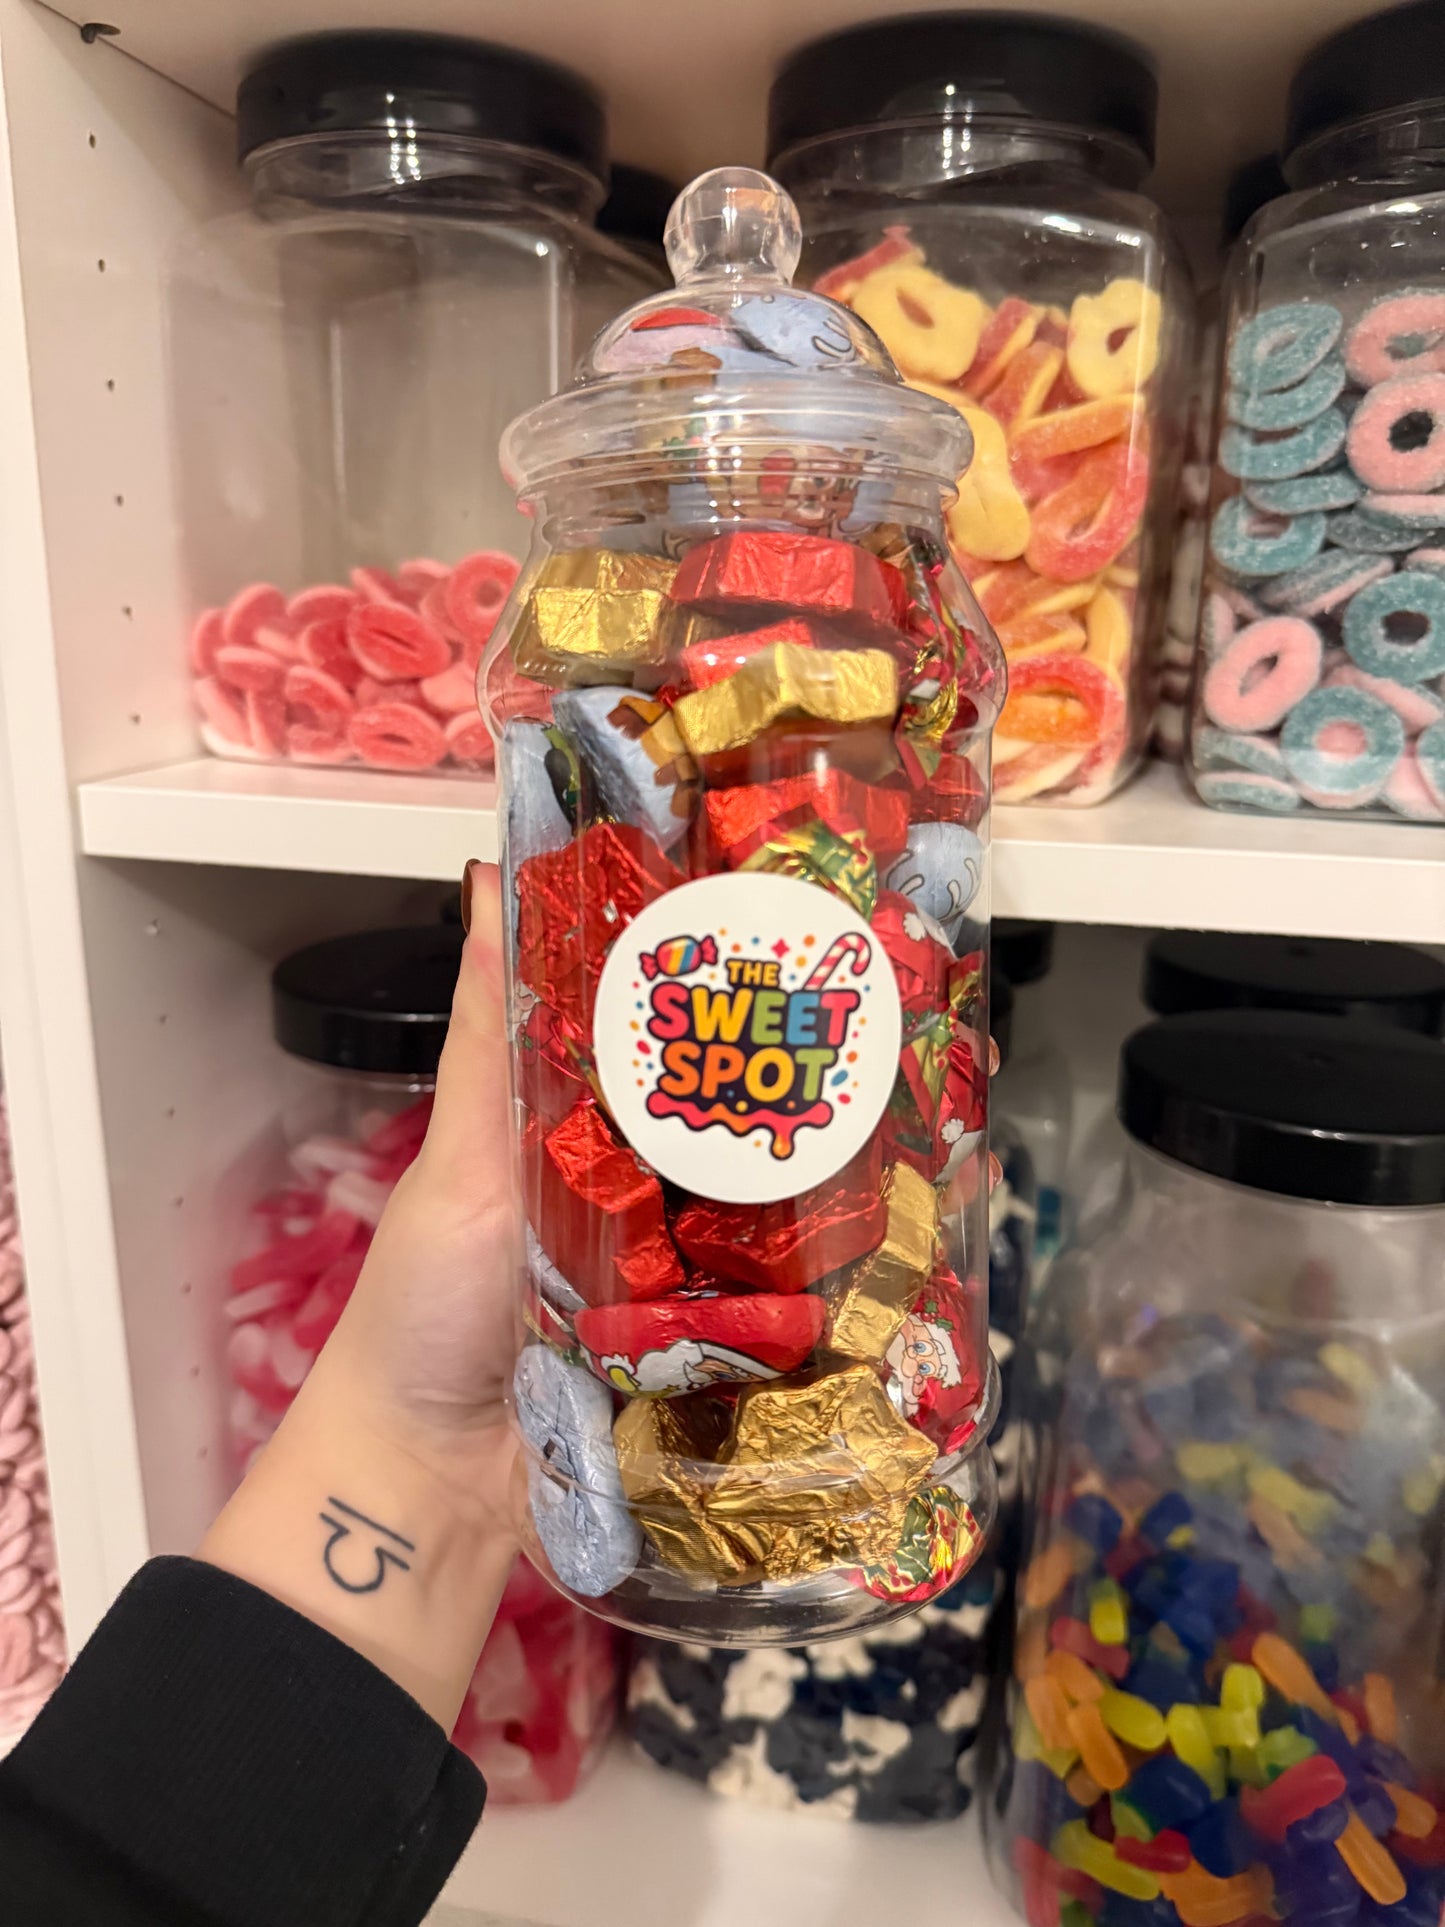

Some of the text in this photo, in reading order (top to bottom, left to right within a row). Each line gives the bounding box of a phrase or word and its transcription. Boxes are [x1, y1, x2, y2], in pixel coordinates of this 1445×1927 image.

[726, 959, 780, 987] THE
[648, 983, 859, 1046] SWEET
[658, 1041, 836, 1102] SPOT
